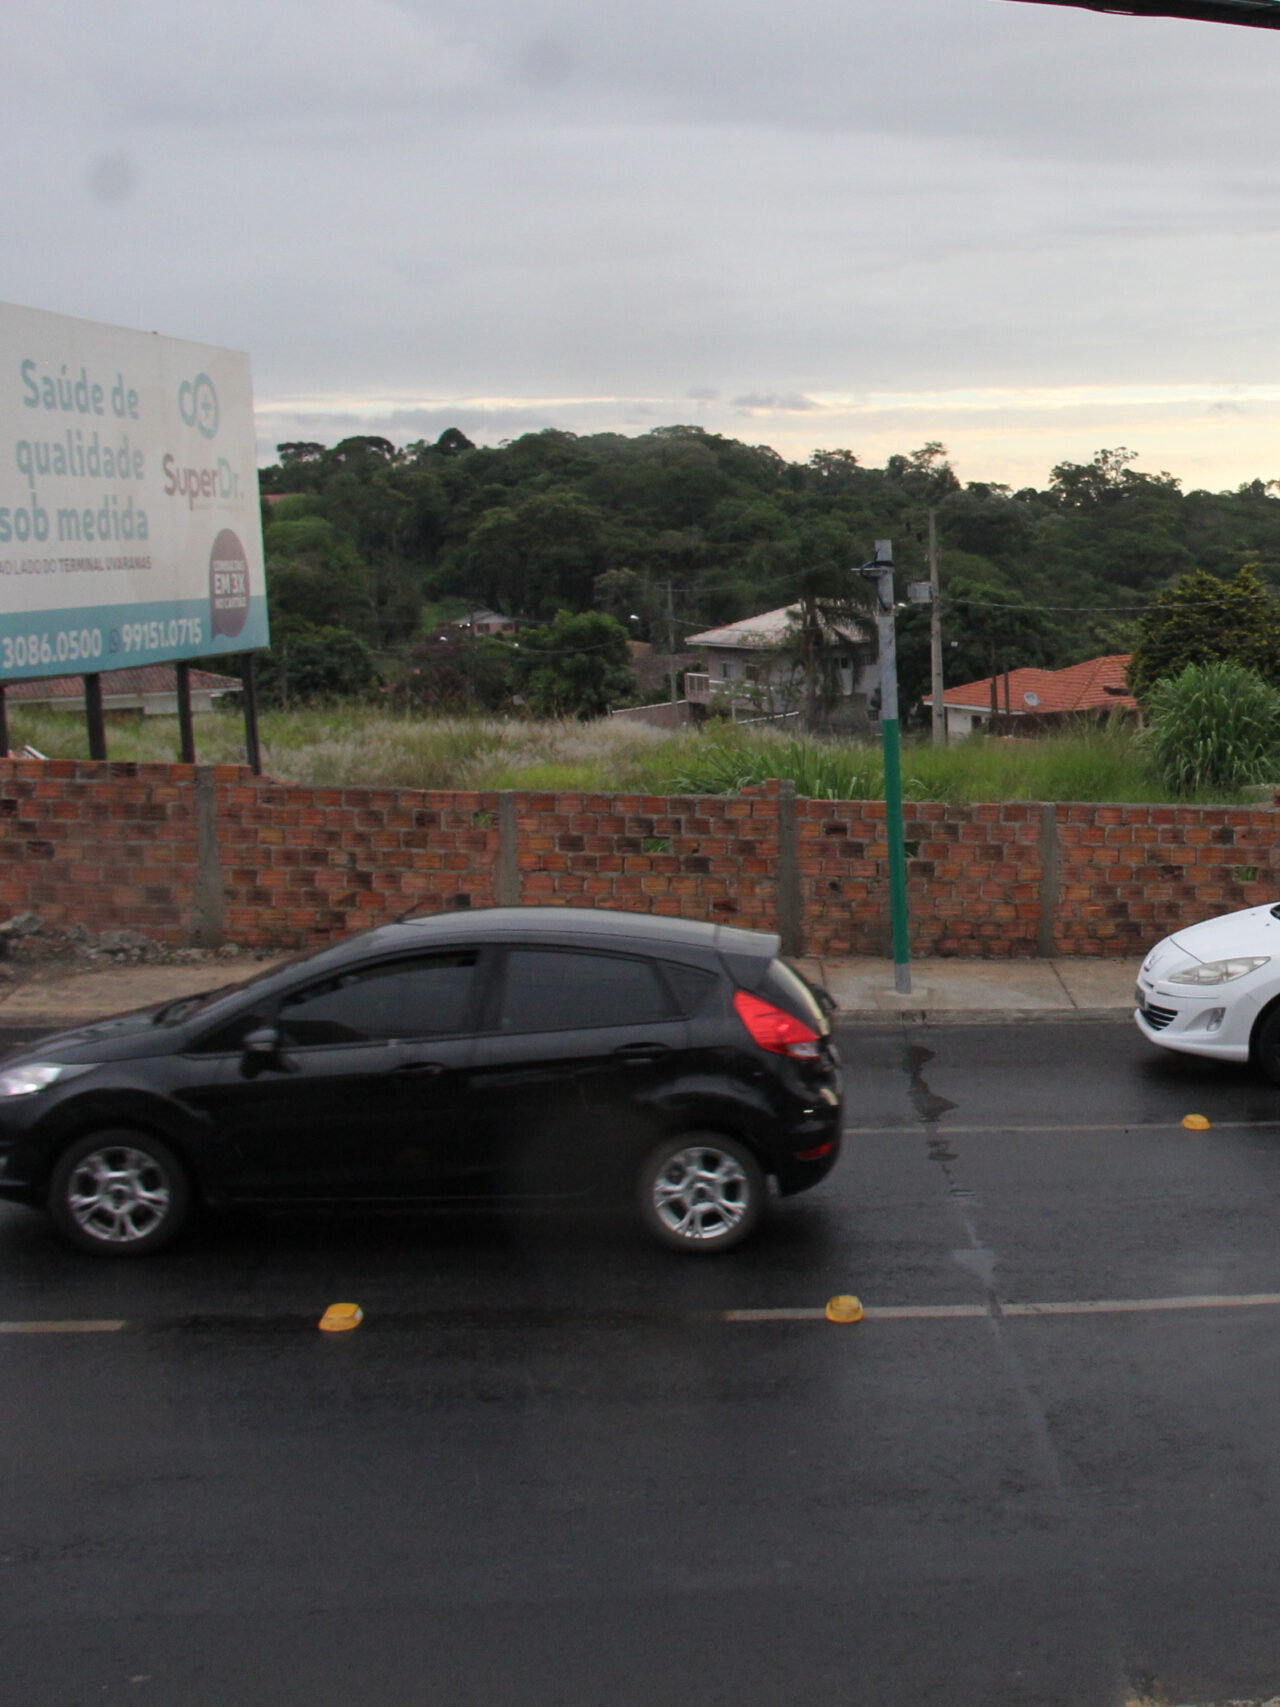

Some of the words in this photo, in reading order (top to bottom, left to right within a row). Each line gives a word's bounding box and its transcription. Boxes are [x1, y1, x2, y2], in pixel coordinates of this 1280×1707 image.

[20, 359, 104, 415] Saúde
[111, 373, 140, 420] de
[16, 428, 145, 489] qualidade
[0, 492, 50, 543] sob
[57, 494, 149, 542] medida
[58, 557, 104, 573] TERMINAL
[2, 627, 102, 669] 3086.0500
[121, 617, 202, 653] 99151.0715
